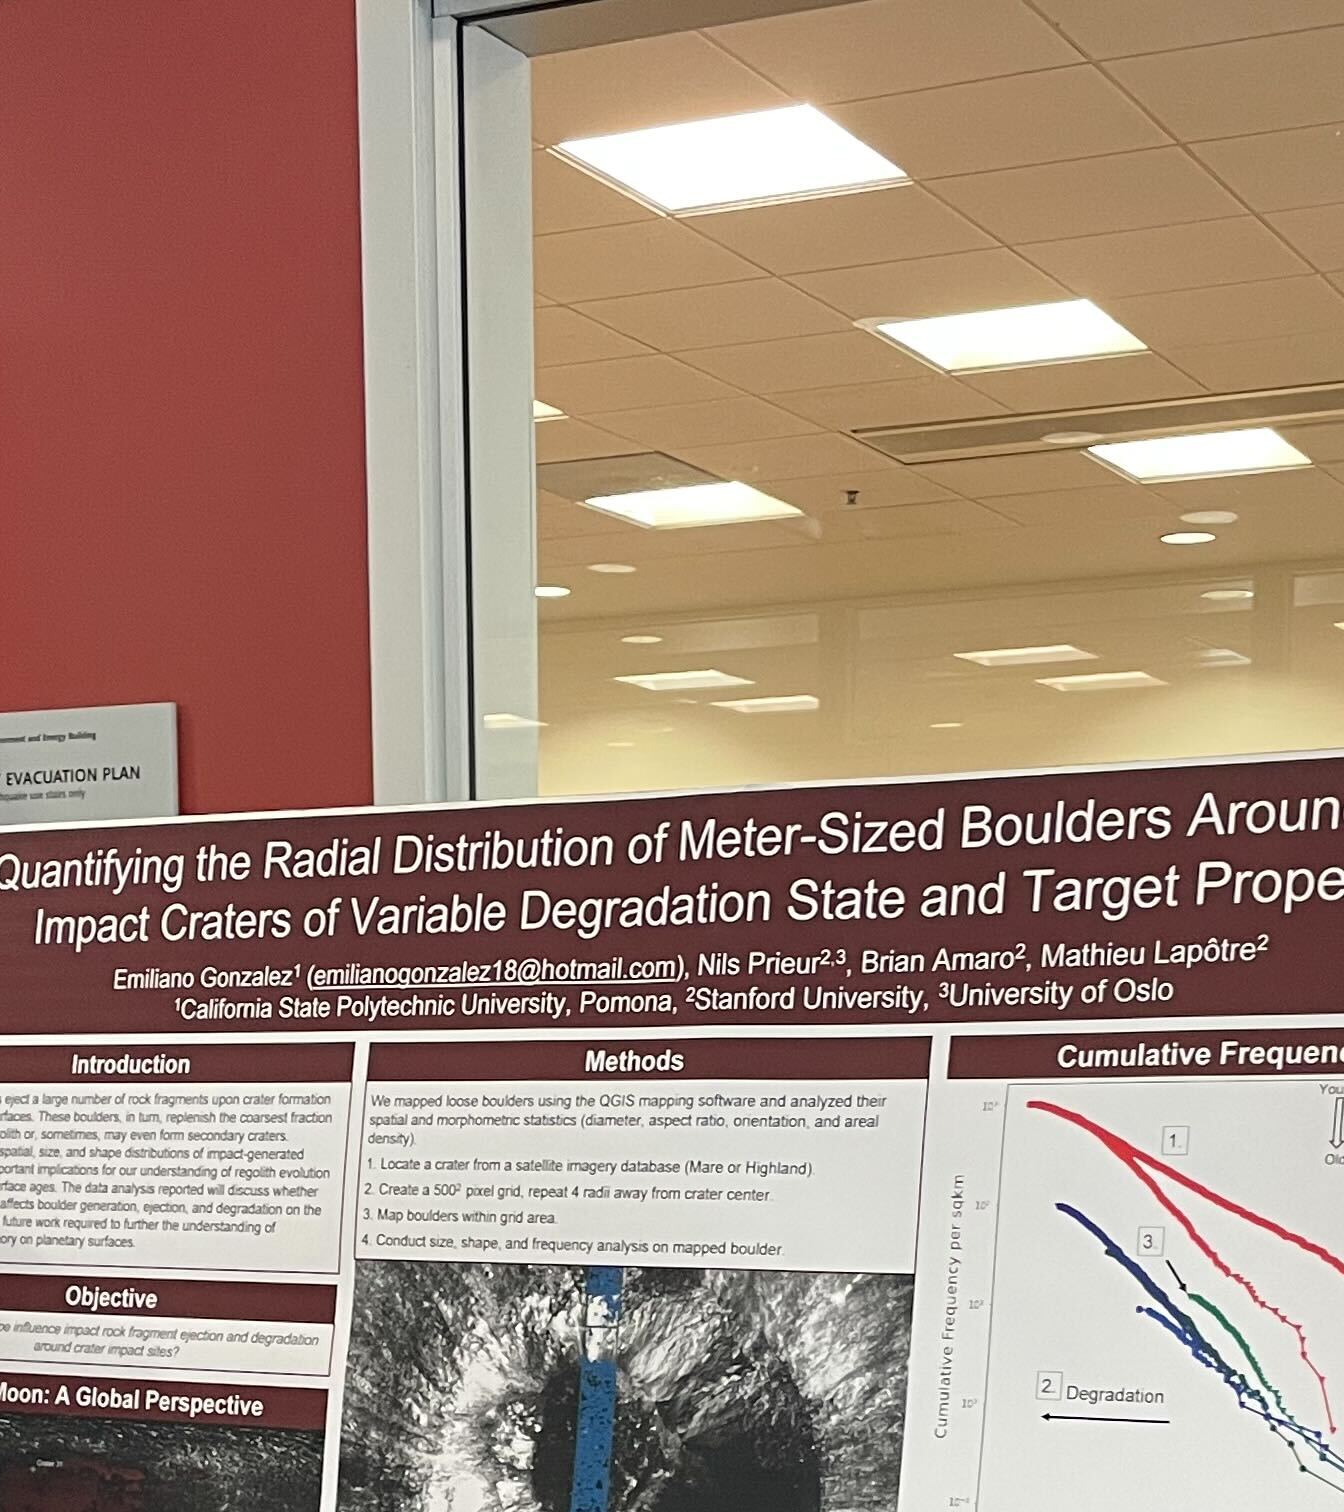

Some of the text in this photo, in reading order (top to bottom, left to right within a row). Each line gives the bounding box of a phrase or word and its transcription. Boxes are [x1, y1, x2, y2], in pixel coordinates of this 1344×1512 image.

[6, 768, 97, 786] EVACUATION
[102, 766, 140, 781] PLAN
[196, 844, 251, 882] the
[264, 836, 381, 879] Radial
[393, 827, 613, 874] Distribution
[628, 821, 670, 864] of
[679, 807, 944, 861] Meter-Sized
[961, 798, 1171, 848] Boulders
[35, 906, 150, 953] Impact
[161, 903, 291, 941] Craters
[304, 897, 342, 937] of
[351, 892, 506, 935] Variable
[520, 882, 770, 939] Degradation
[787, 878, 905, 920] State
[920, 871, 1006, 917] and
[1022, 865, 1180, 921] Target
[113, 968, 194, 989] Emiliano
[697, 952, 740, 976] Nils
[861, 949, 924, 973] Brian
[1041, 941, 1145, 968] Mathieu
[278, 996, 330, 1018] State
[336, 994, 455, 1022] Polytechnic
[461, 991, 571, 1019] University,
[579, 990, 677, 1014] Pomona,
[803, 984, 928, 1012] University,
[1080, 978, 1108, 1004] of
[1114, 977, 1174, 1002] Oslo
[71, 1053, 190, 1074] Introduction
[585, 1048, 684, 1072] Methods
[1057, 1041, 1211, 1068] Cumulative
[65, 1285, 158, 1311] Objective
[54, 1385, 70, 1405] A
[76, 1385, 140, 1409] Global
[145, 1389, 264, 1417] Perspective
[1066, 1385, 1164, 1404] Degradation
